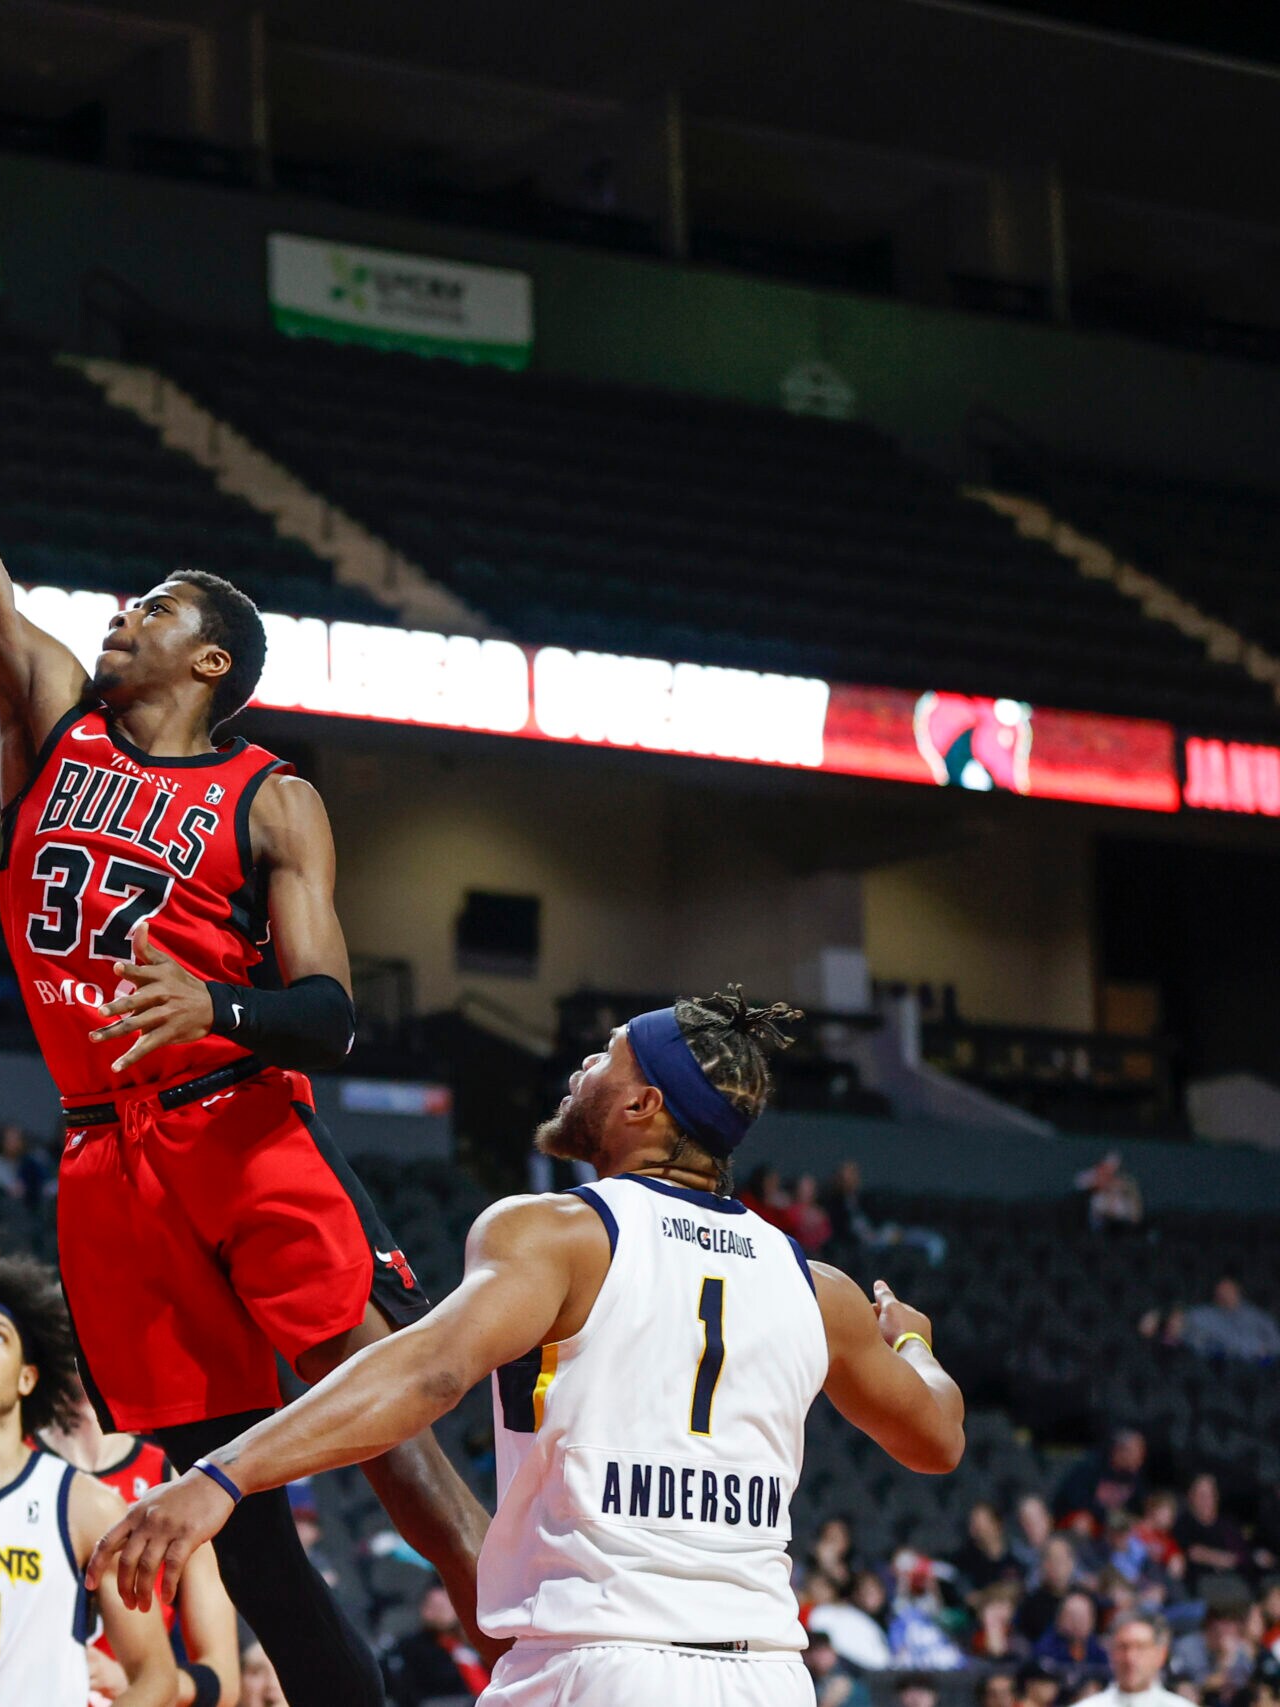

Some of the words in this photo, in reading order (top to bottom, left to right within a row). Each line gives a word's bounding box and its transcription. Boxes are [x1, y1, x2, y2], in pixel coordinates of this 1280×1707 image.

[35, 758, 219, 880] BULLS
[26, 841, 176, 962] 37
[33, 979, 104, 1009] BMO
[672, 1218, 697, 1245] NBA
[713, 1229, 757, 1259] LEAGUE
[688, 1275, 726, 1437] 1
[601, 1461, 782, 1528] ANDERSON
